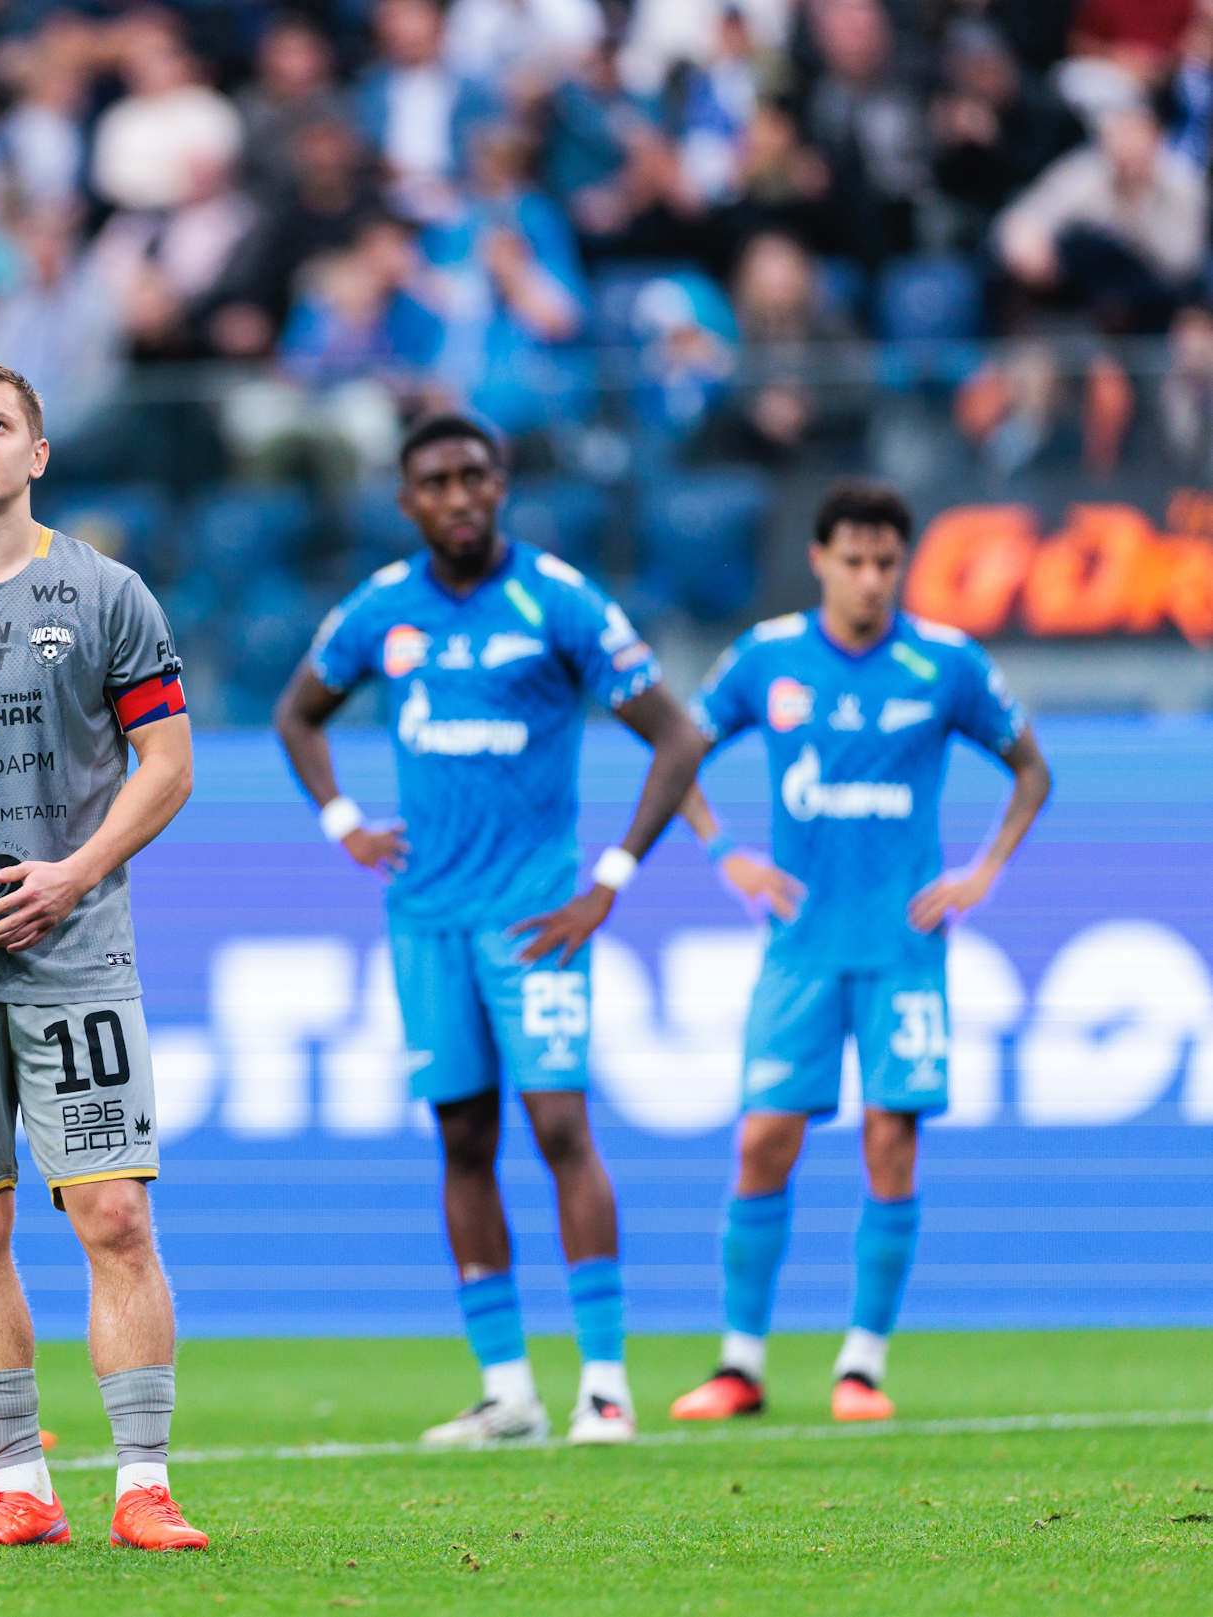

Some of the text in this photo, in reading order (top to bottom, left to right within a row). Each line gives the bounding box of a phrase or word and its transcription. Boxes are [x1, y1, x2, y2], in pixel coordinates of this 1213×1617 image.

[31, 580, 78, 605] wb
[30, 626, 72, 645] ЦСКА
[522, 970, 587, 1037] 25
[890, 990, 949, 1060] 31
[43, 1009, 131, 1095] 10
[62, 1099, 125, 1127] ВЭБ
[65, 1129, 128, 1155] РФ
